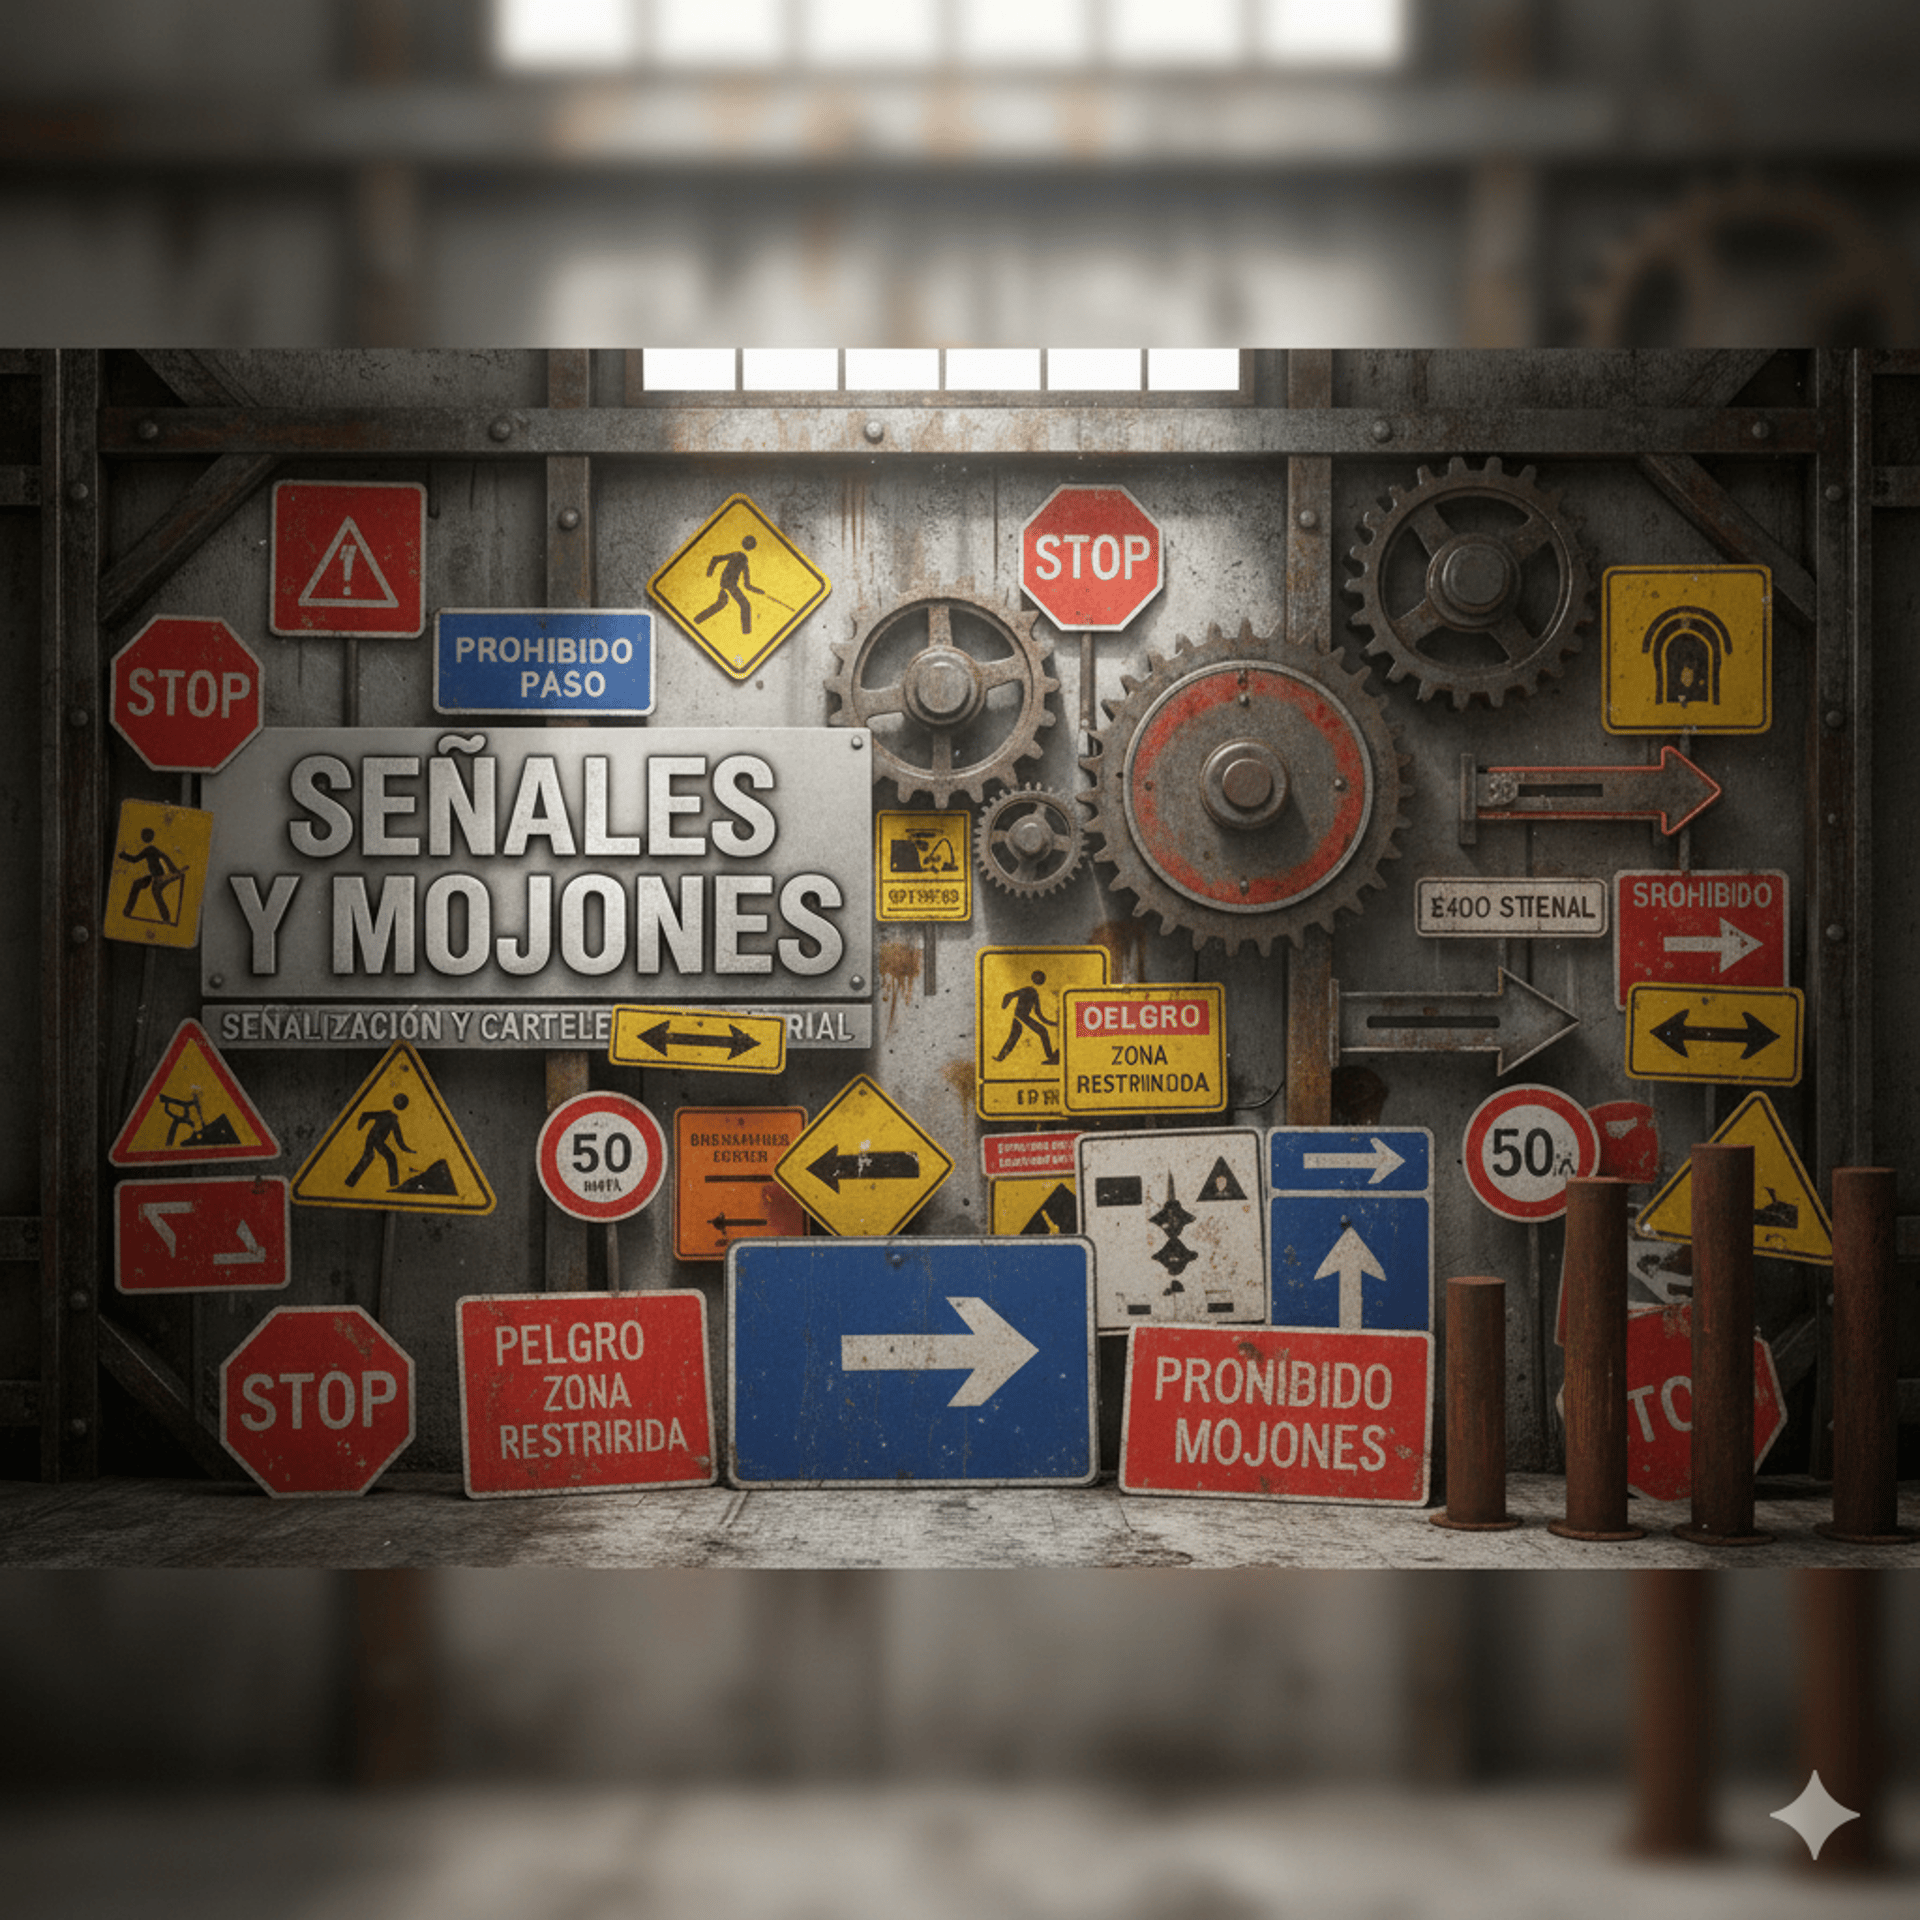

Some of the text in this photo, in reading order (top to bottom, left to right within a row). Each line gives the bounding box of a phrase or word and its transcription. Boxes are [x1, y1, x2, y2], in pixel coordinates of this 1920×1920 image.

[1036, 534, 1151, 581] STOP
[456, 637, 634, 666] PROHIBIDO
[127, 667, 251, 718] STOP
[520, 671, 606, 699] PASO
[289, 733, 778, 858] SEÑALES
[229, 873, 843, 976] Y MOJONES
[222, 1004, 856, 1041] SEÑALIZACIÓN Y CARTELE RIAL
[1111, 1045, 1169, 1066] ZONA
[572, 1132, 632, 1174] 50
[1492, 1127, 1554, 1178] 50
[495, 1319, 645, 1367] PELGRO
[240, 1370, 398, 1433] STOP
[542, 1372, 633, 1413] ZONA
[1627, 1375, 1692, 1443] TO
[500, 1417, 690, 1461] RESTRIRIDA
[1175, 1417, 1388, 1472] MOJONES
